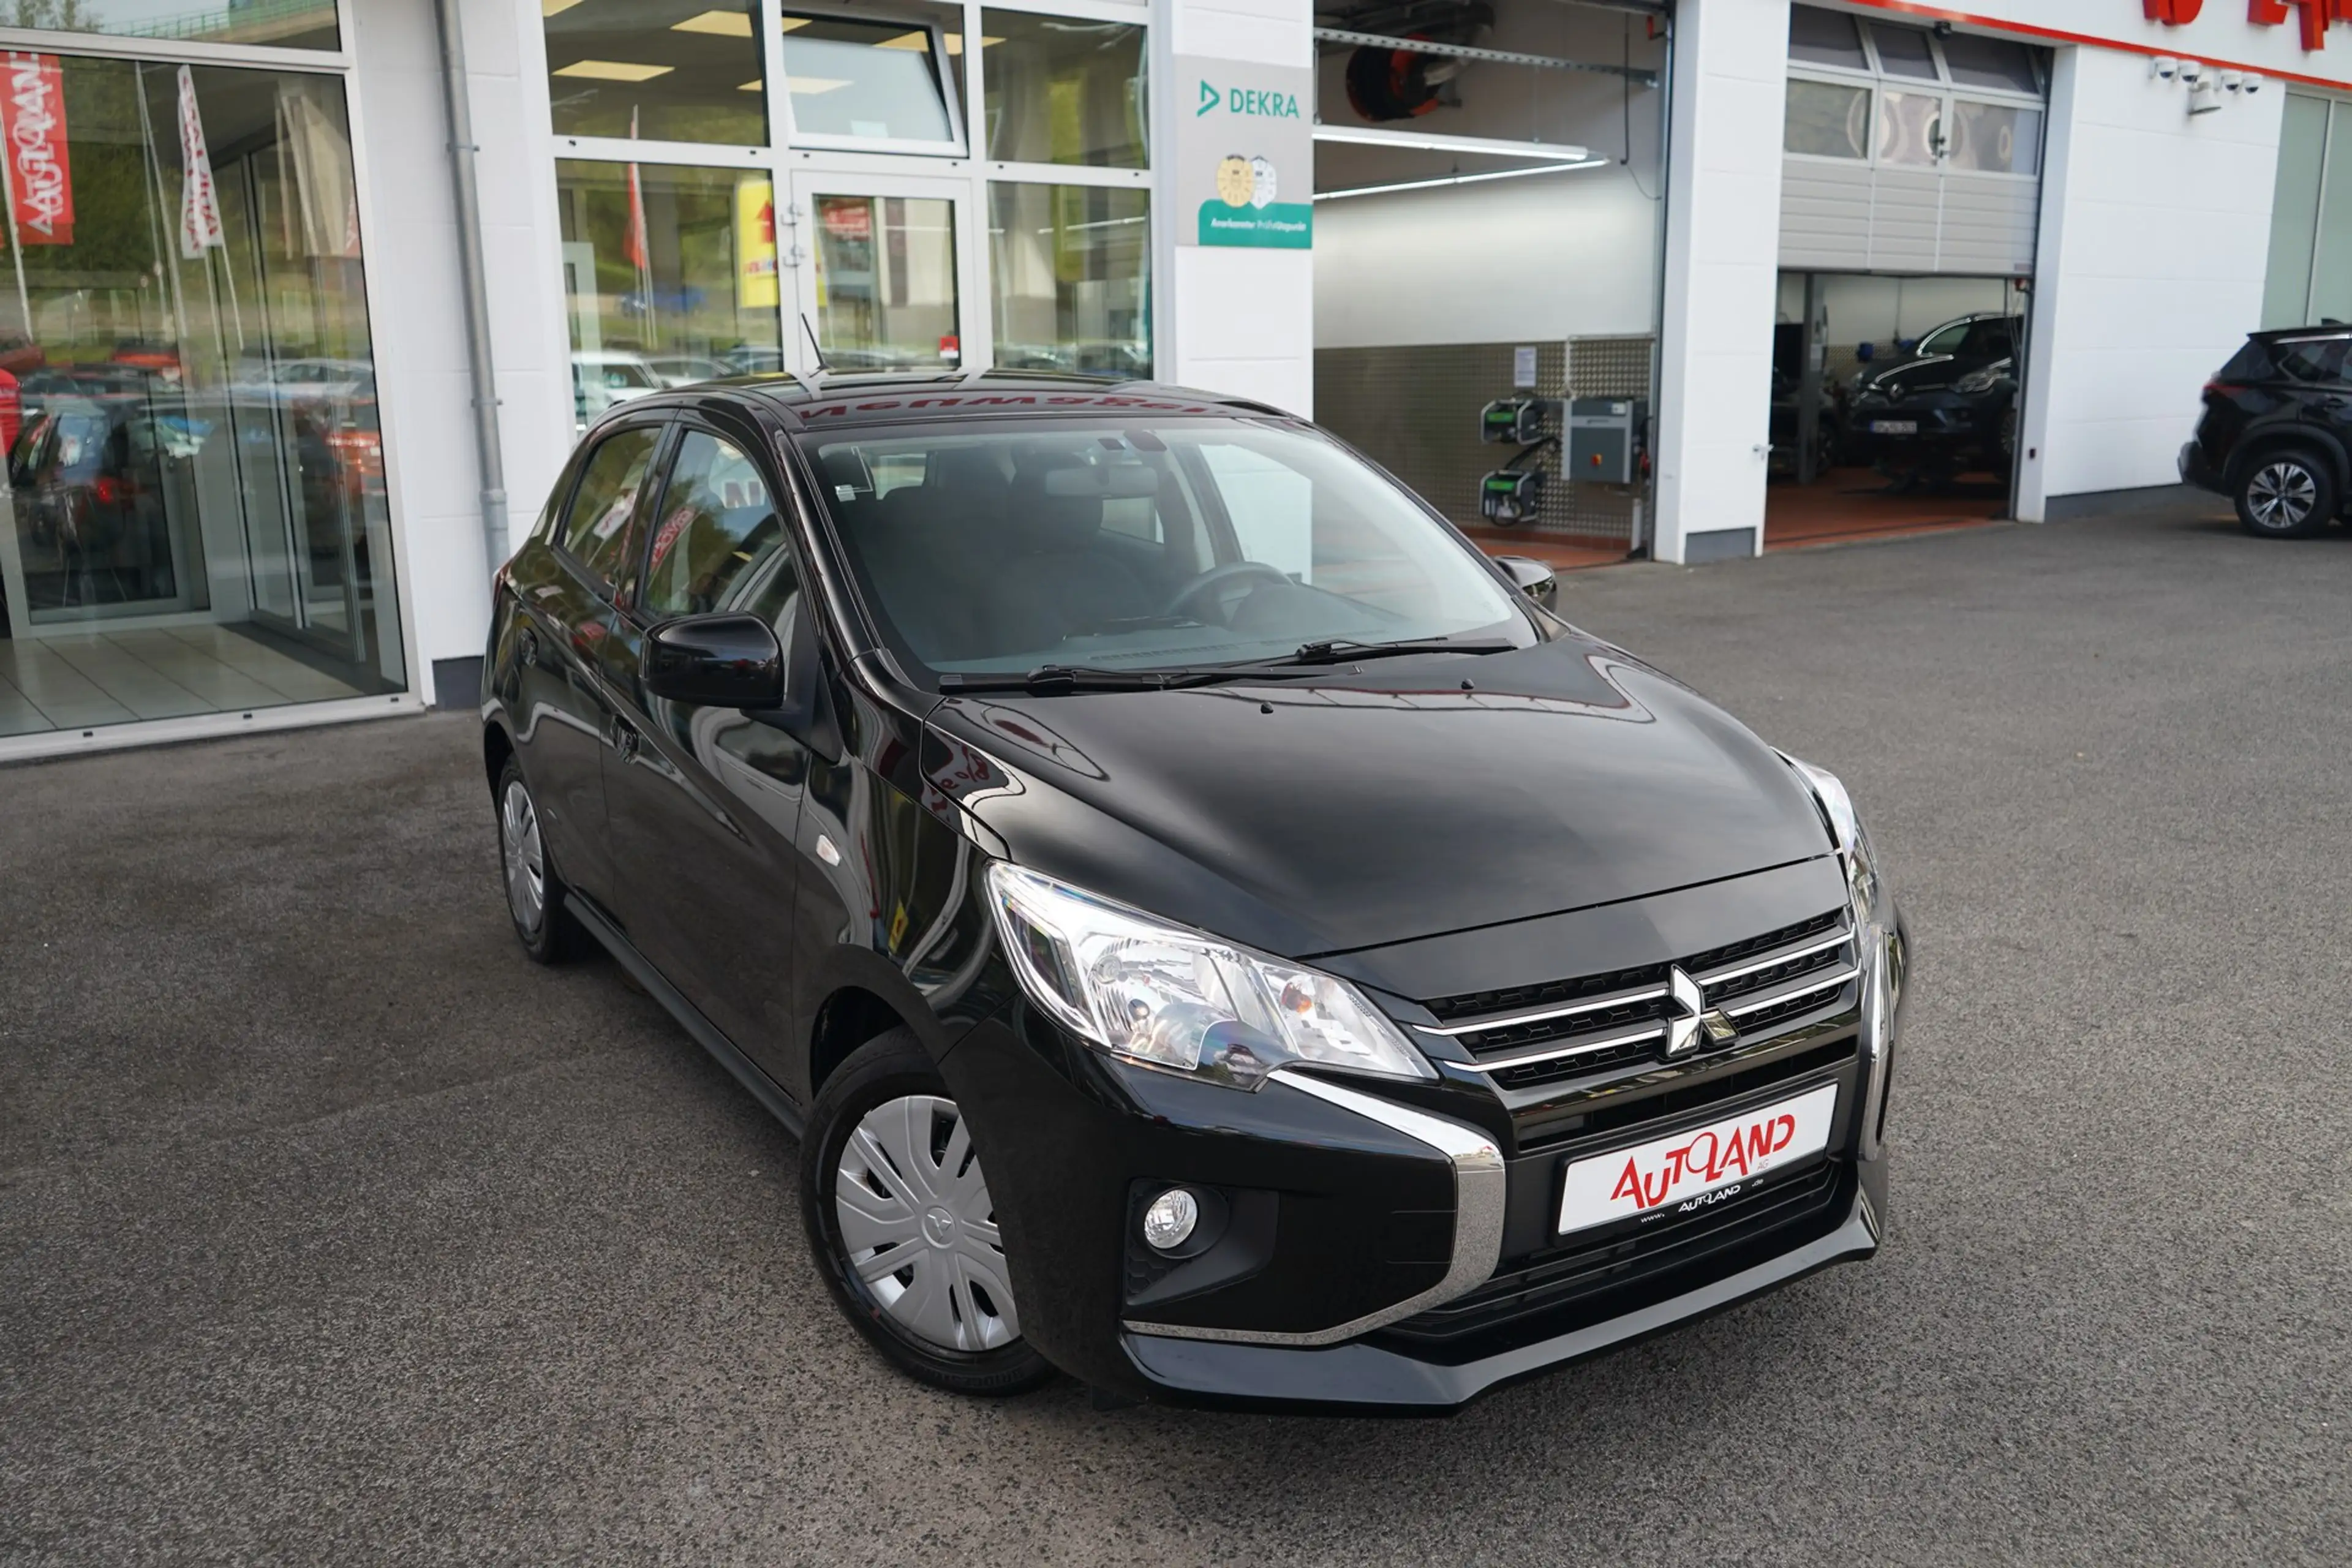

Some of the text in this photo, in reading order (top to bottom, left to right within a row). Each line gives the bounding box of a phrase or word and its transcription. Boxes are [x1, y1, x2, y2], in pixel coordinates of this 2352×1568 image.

[1229, 88, 1300, 118] DEKRA
[1757, 1158, 1770, 1171] AG
[1640, 1213, 1665, 1223] www.
[1678, 1184, 1741, 1213] AUTOLAND
